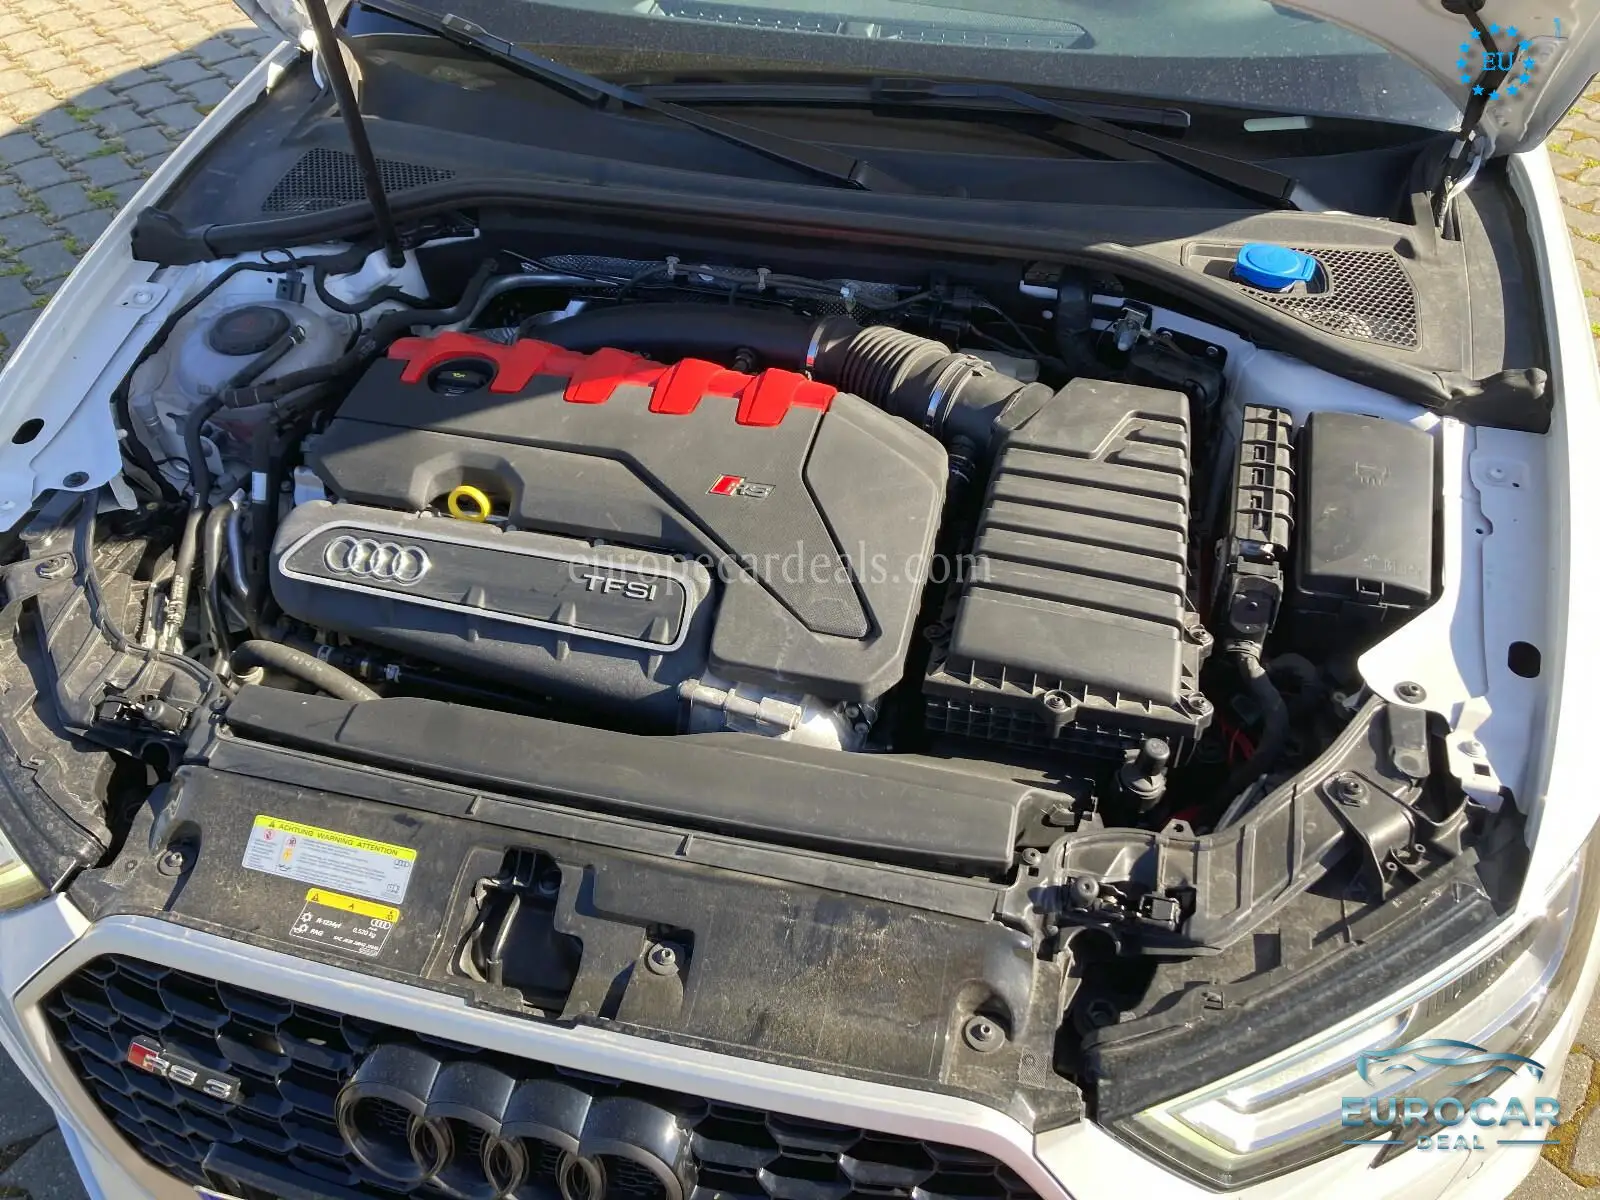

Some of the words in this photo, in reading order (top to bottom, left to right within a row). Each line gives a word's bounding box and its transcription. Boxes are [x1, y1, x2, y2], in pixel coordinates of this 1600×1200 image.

[582, 573, 657, 600] TFSI
[279, 824, 313, 837] ACHTUNG
[317, 833, 353, 846] WARNING
[357, 842, 398, 856] ATTENTION
[138, 1050, 197, 1085] RS
[203, 1079, 231, 1099] 3
